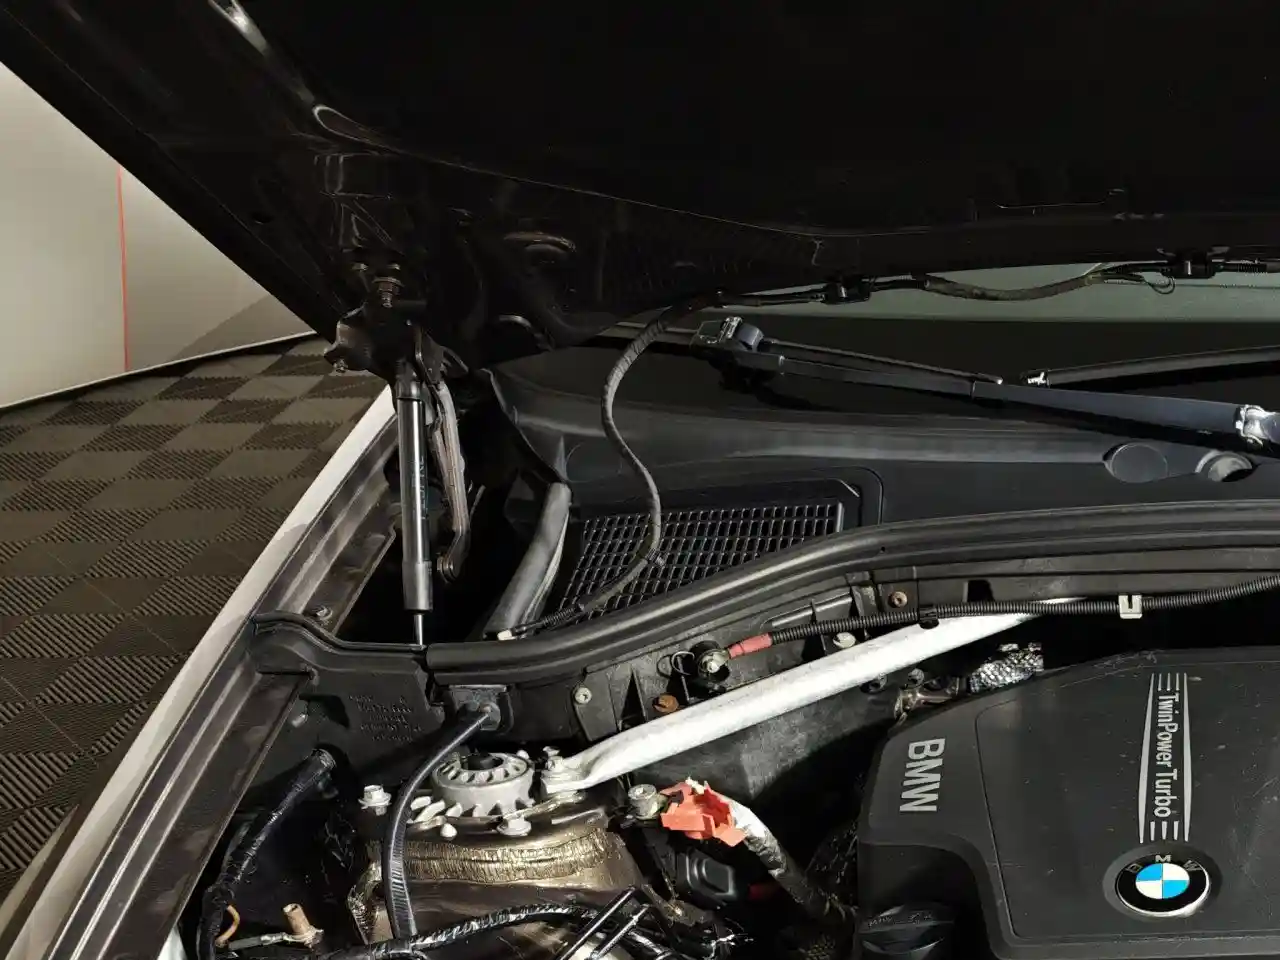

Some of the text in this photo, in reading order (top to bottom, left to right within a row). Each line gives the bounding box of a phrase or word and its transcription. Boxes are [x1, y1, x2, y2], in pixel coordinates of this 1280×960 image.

[899, 738, 945, 812] BMW
[1153, 692, 1179, 818] TwinPower Turbo
